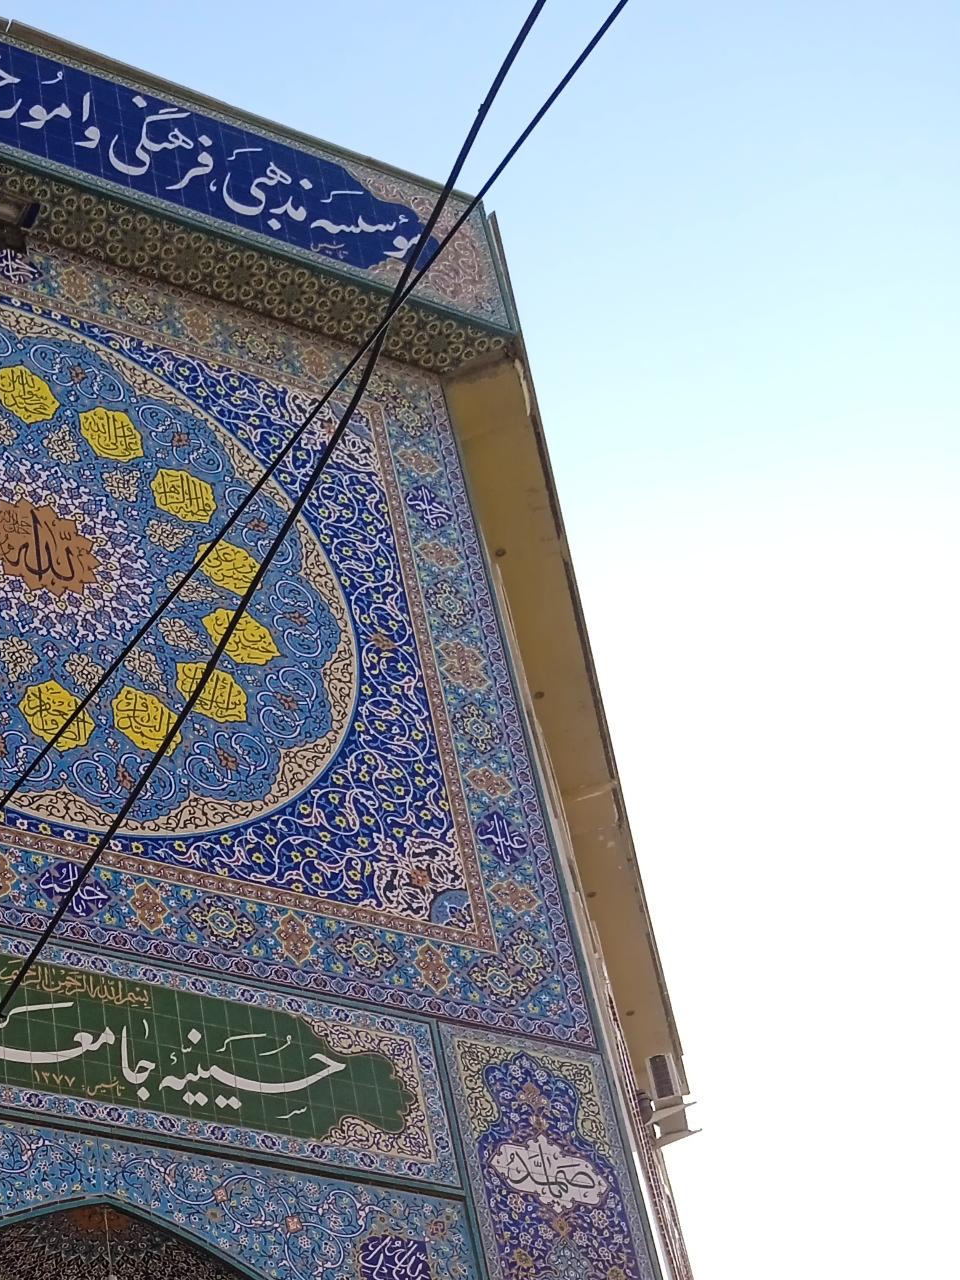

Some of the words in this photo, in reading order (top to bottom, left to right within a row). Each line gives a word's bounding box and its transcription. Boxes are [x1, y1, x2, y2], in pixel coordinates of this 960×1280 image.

[74, 126, 101, 149] و
[109, 95, 214, 190] فرهنگی
[0, 508, 76, 583] الله
[114, 987, 153, 1010] بسم
[33, 1069, 76, 1088] ۱۳۷۷
